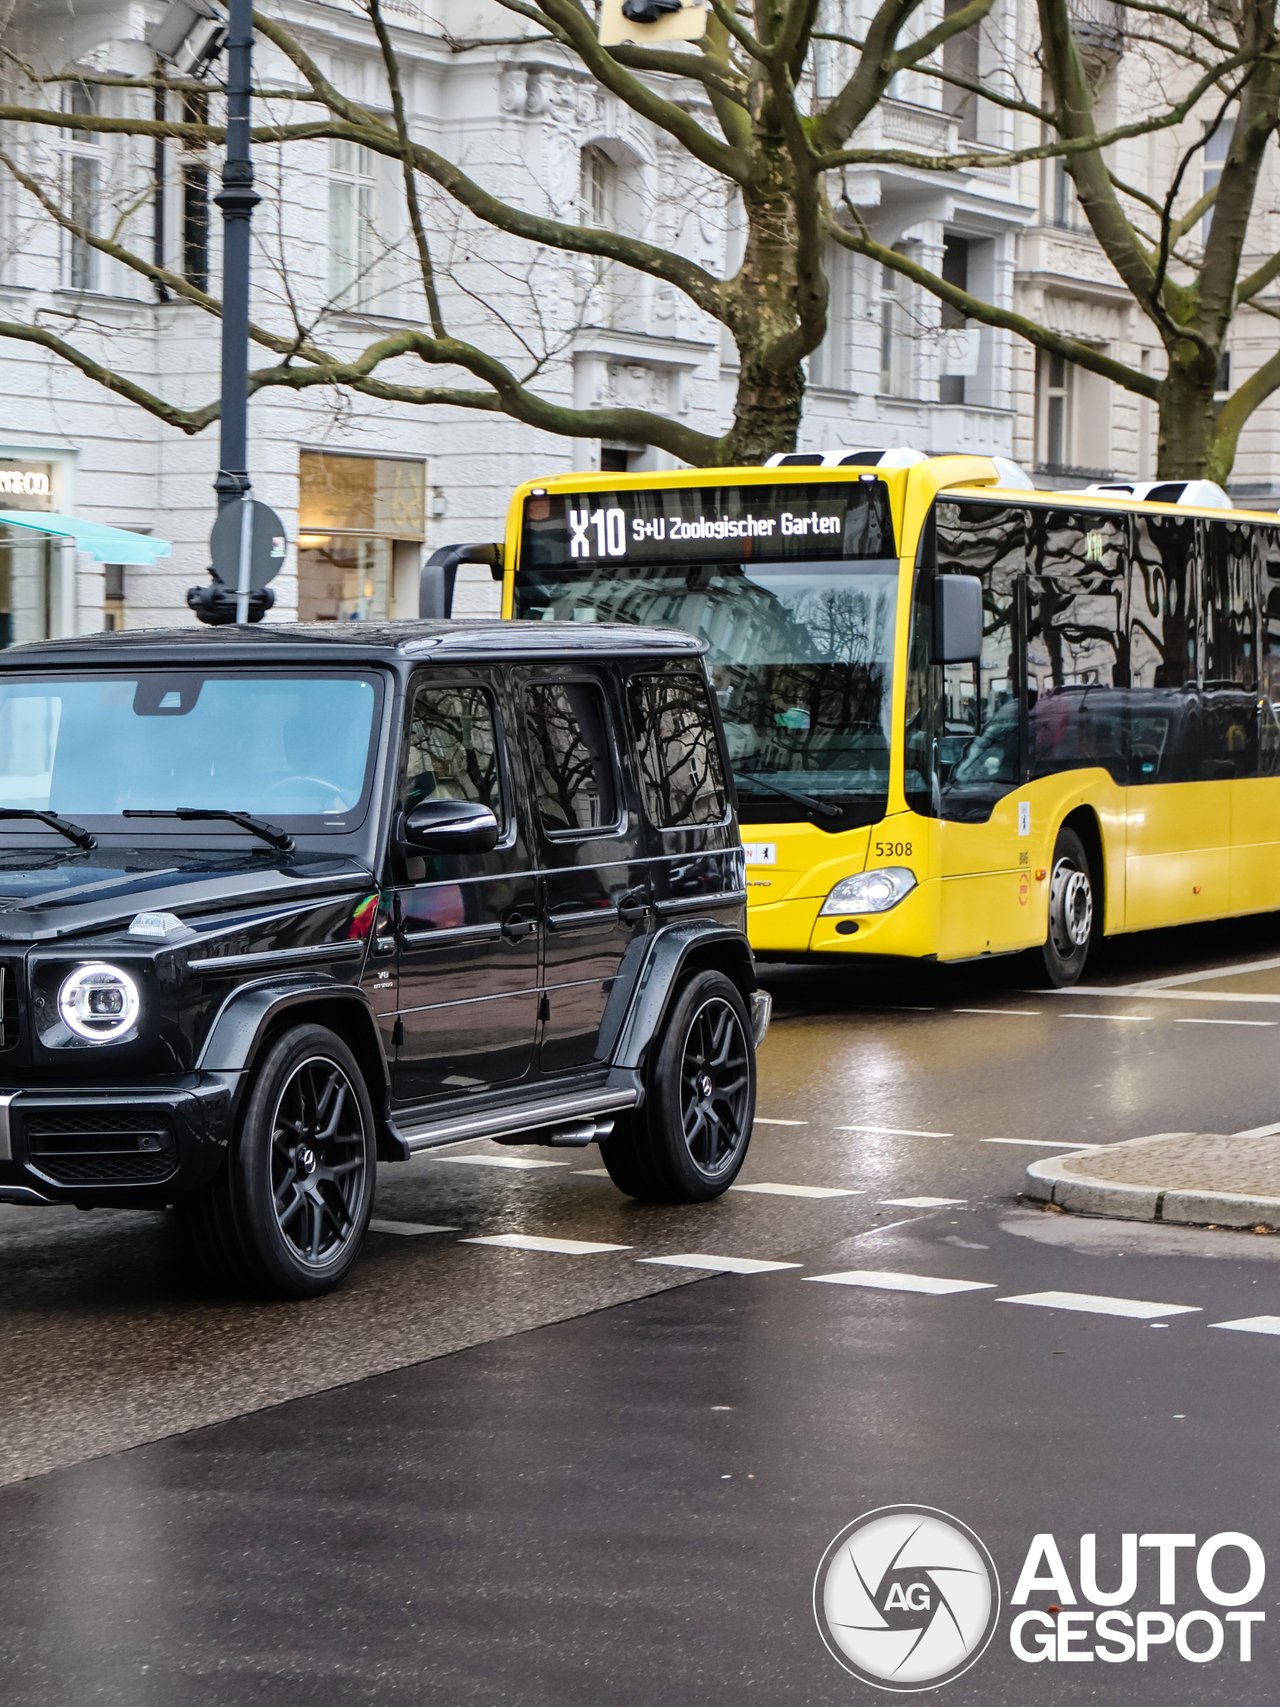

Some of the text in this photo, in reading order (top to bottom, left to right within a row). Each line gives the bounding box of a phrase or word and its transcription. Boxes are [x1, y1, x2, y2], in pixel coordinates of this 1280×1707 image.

[569, 508, 841, 558] X10 S+U Zoologischer Garten
[875, 842, 913, 857] 5308
